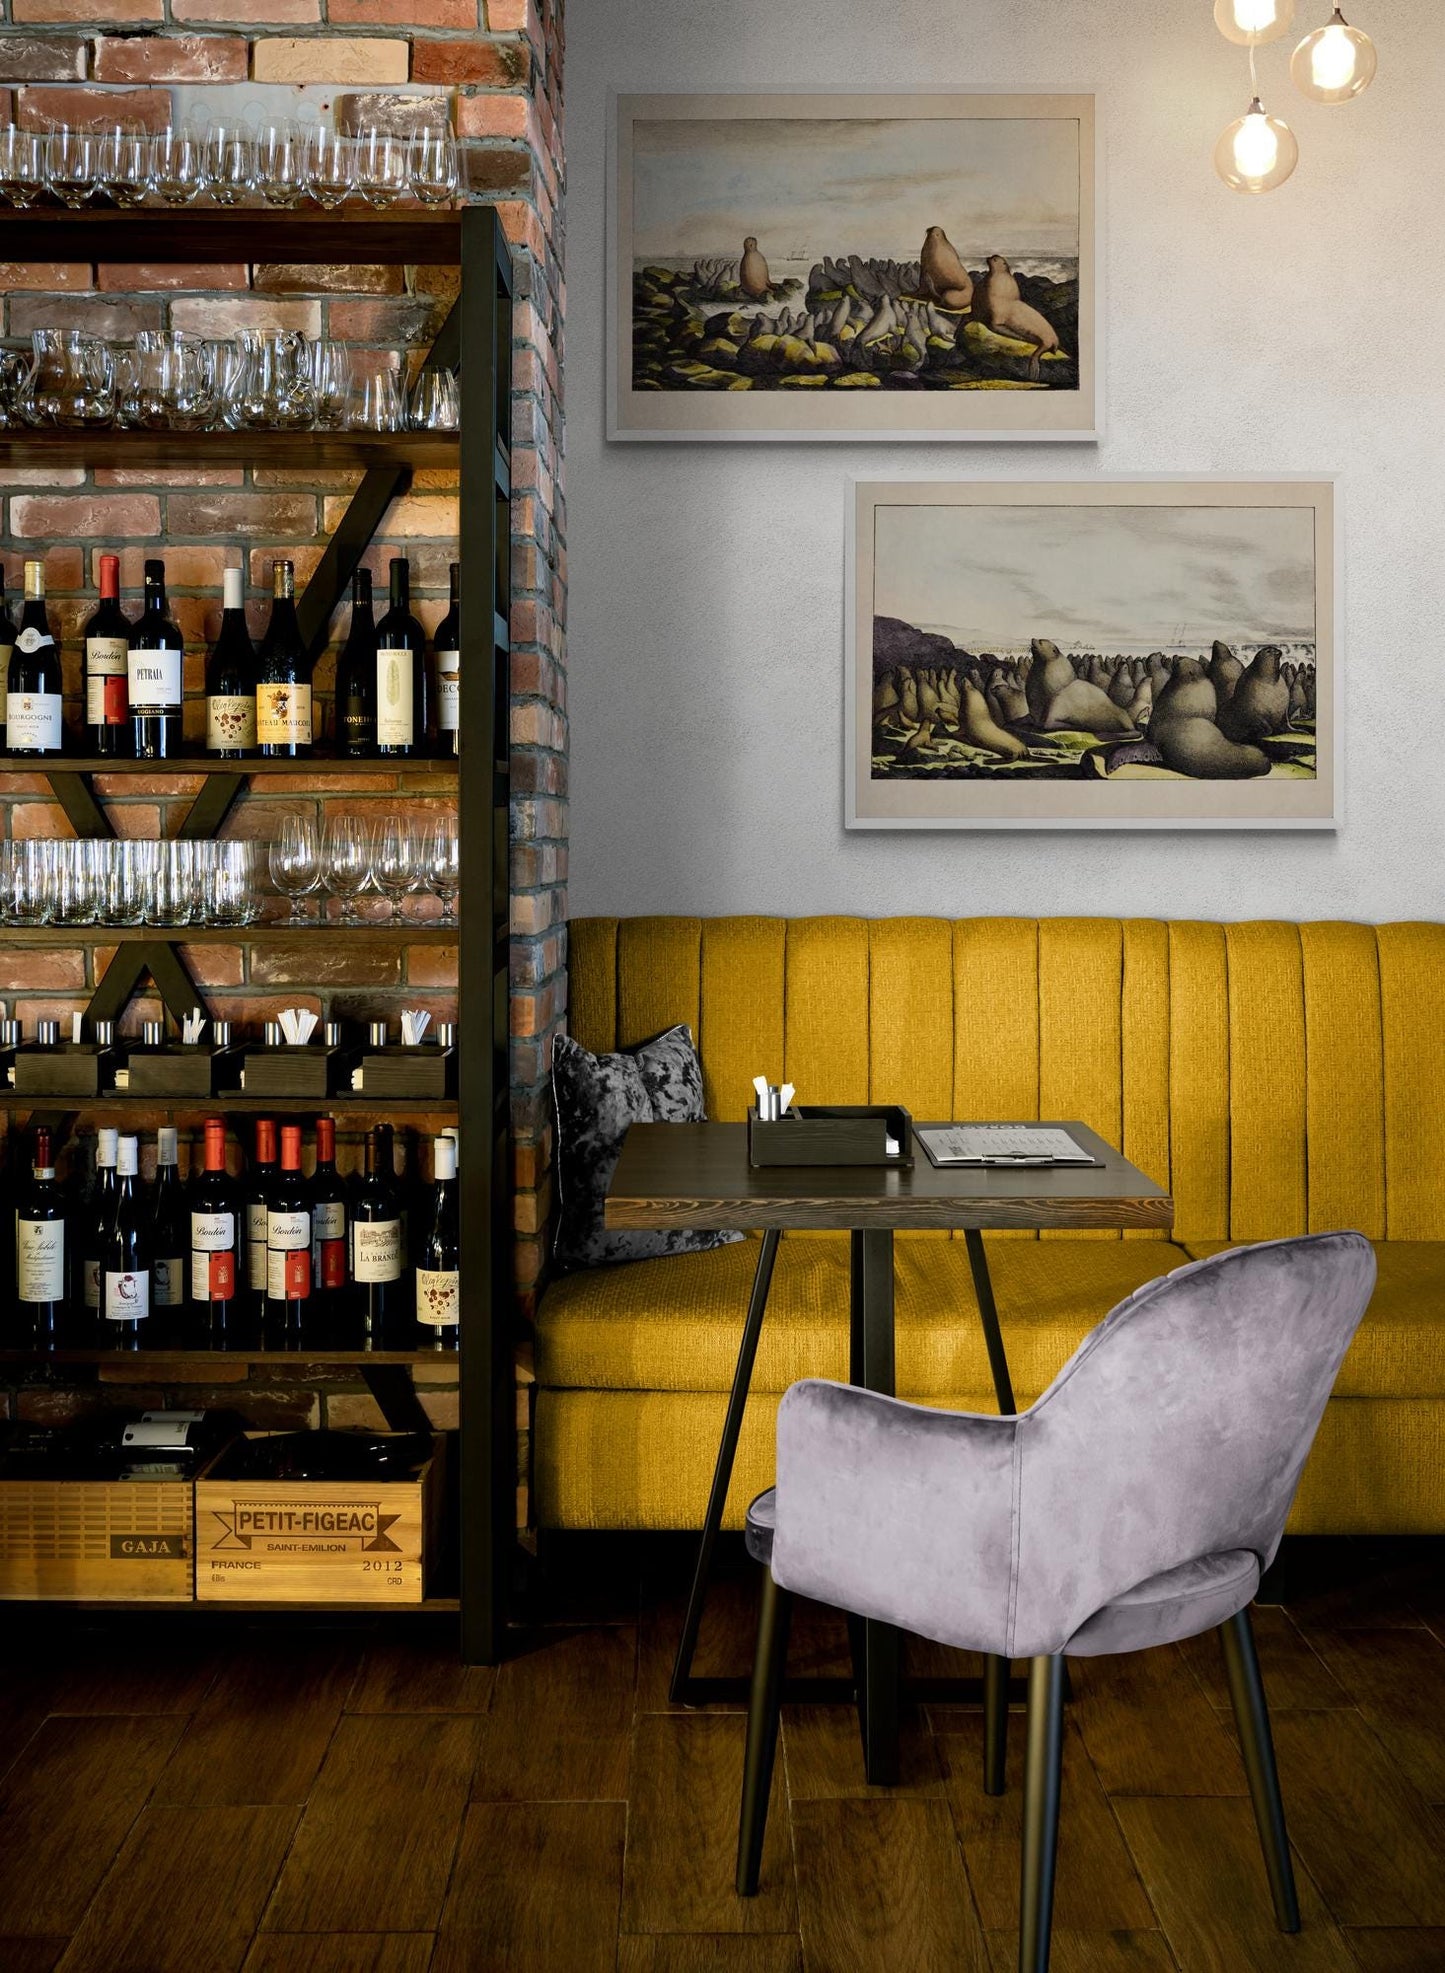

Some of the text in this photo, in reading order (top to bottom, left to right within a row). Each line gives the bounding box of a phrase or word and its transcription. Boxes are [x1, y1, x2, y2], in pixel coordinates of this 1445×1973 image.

[239, 1511, 375, 1532] PETIT-FIGEAC
[121, 1540, 171, 1554] GAJA
[267, 1543, 347, 1553] SAINT-EMILION
[211, 1560, 403, 1571] FRANCE 2012
